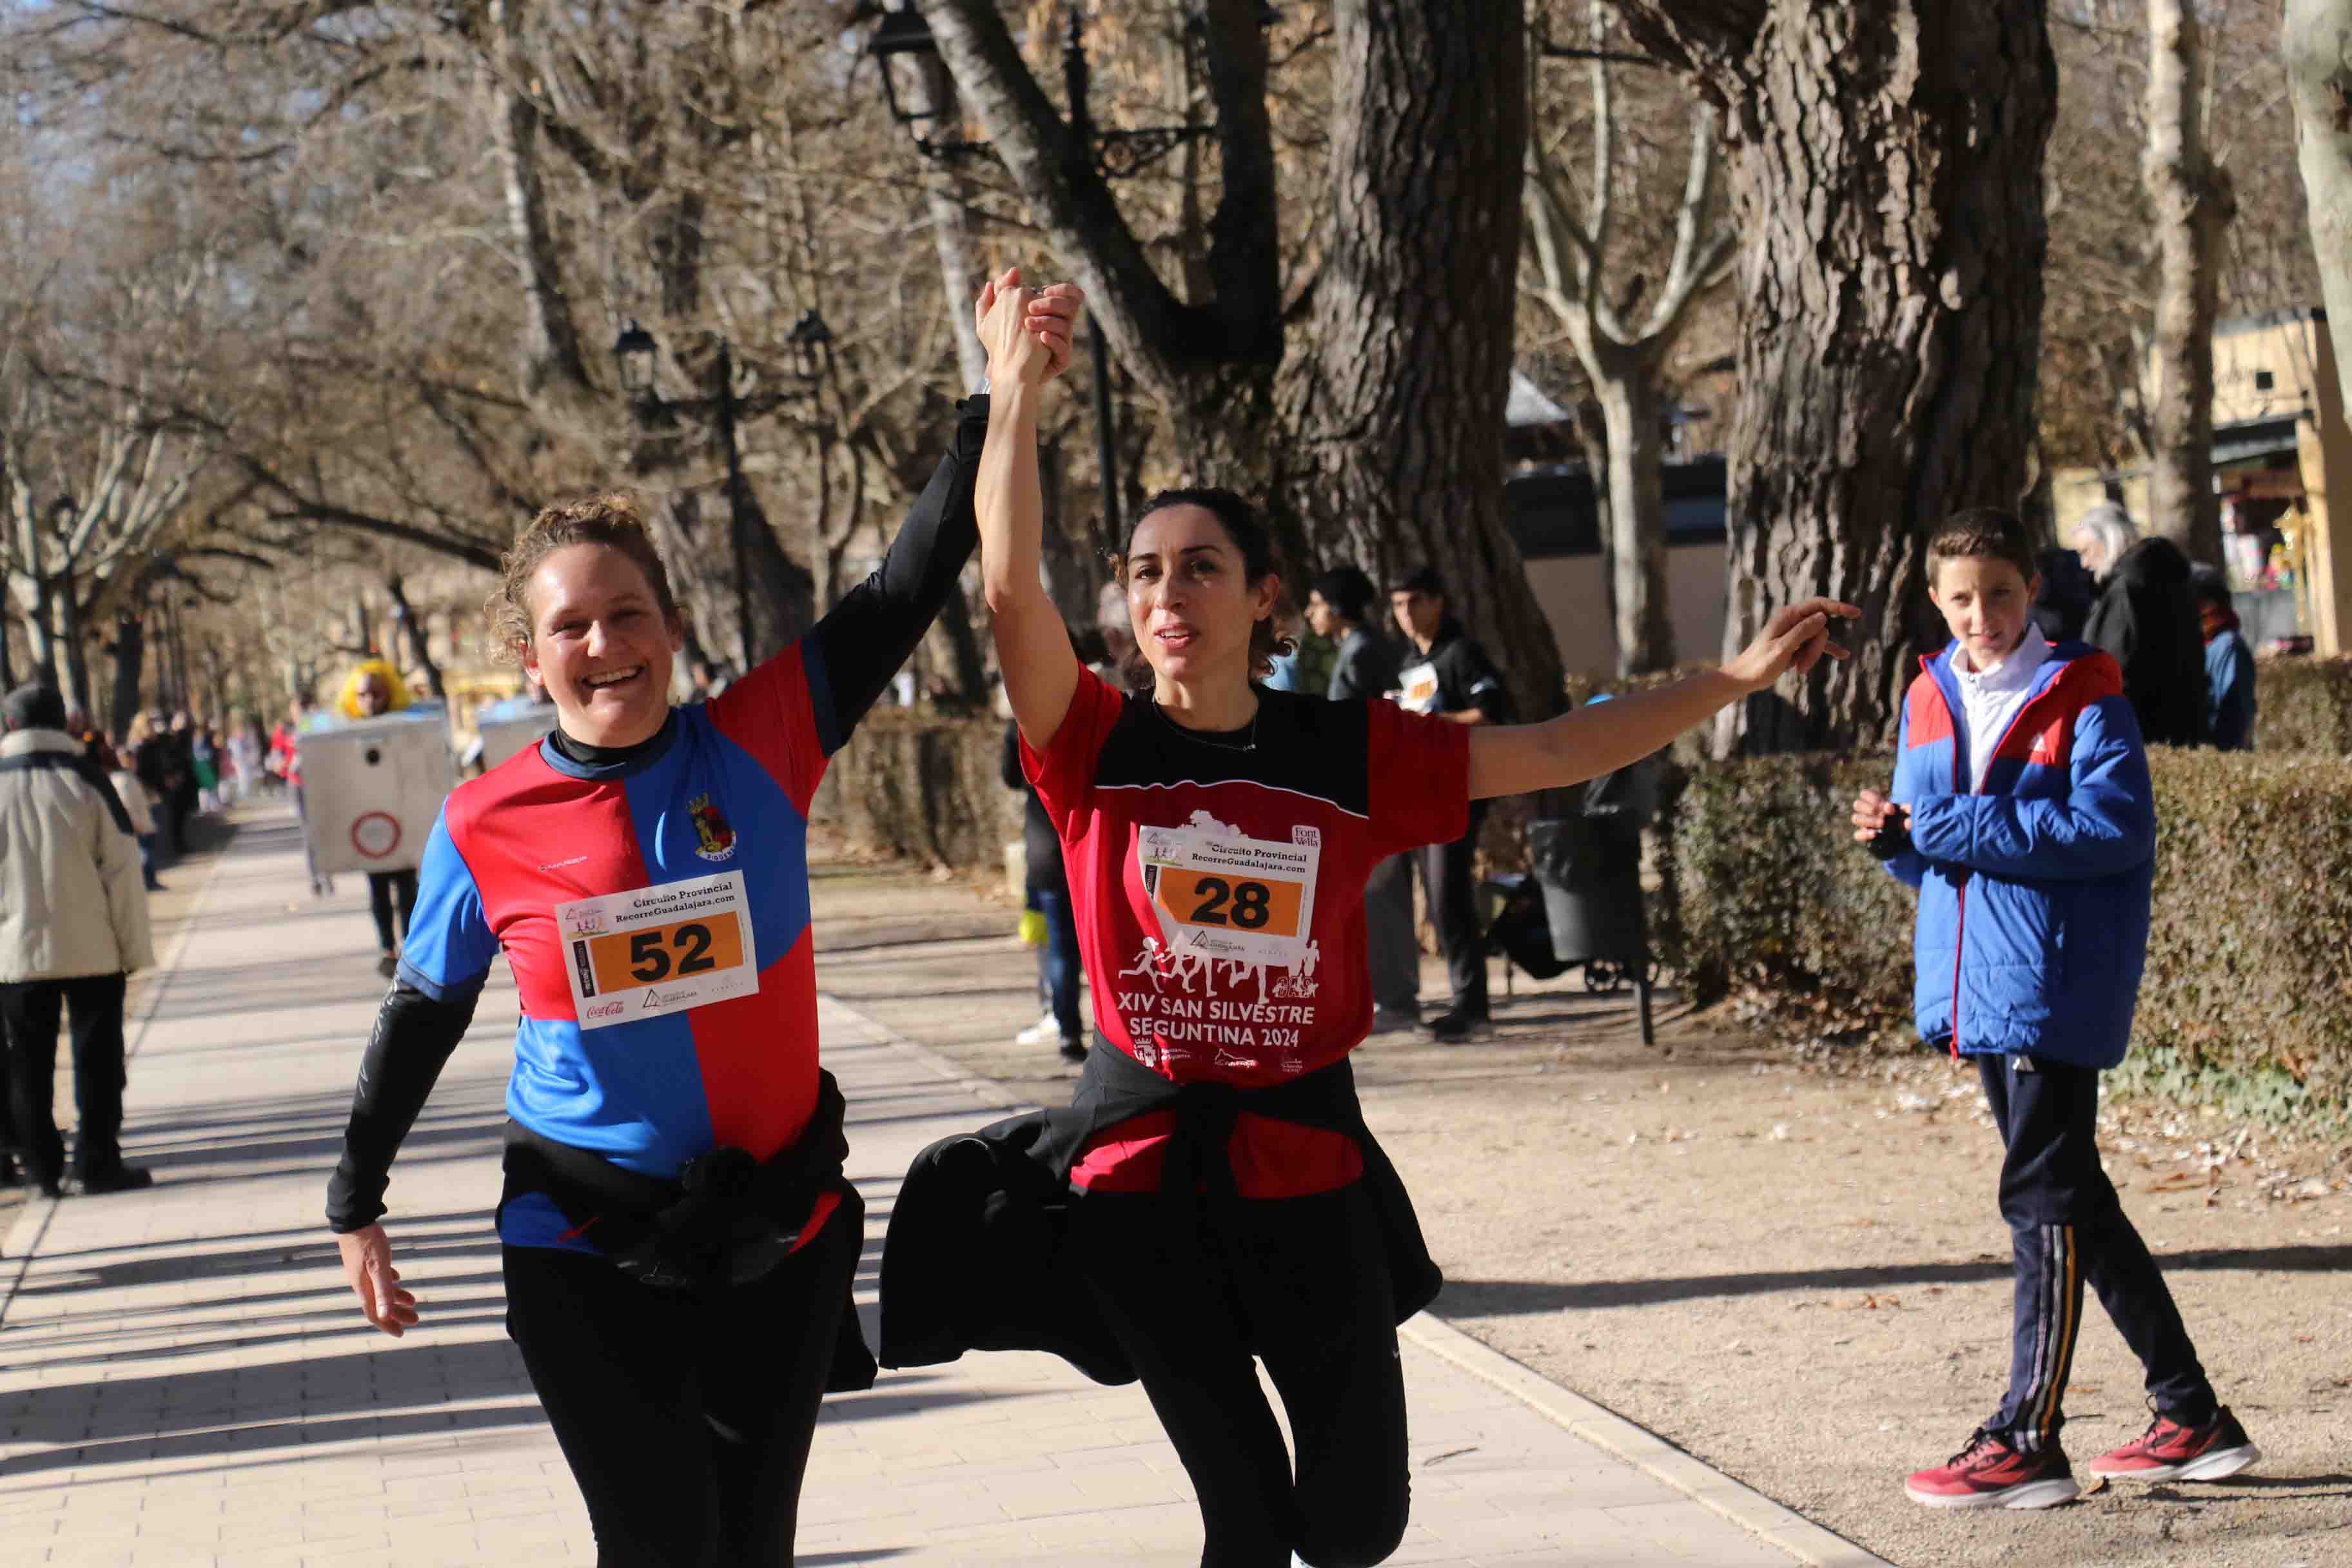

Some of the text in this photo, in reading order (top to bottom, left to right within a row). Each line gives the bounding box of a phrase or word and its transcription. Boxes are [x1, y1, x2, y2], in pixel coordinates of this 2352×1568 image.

[1295, 826, 1317, 838] Font
[1295, 836, 1318, 847] Vella
[1191, 853, 1306, 874] RecorreGuadalajara.com
[1211, 844, 1308, 863] Circuito Provincial
[615, 894, 735, 923] RecorreGuadalajara.com
[633, 882, 733, 909] Circuito Provincial
[1190, 876, 1271, 930] 28
[630, 924, 716, 983] 52
[1117, 992, 1315, 1025] XIV SAN SILVESTRE
[1129, 1017, 1300, 1048] SEGUNTINA 2024
